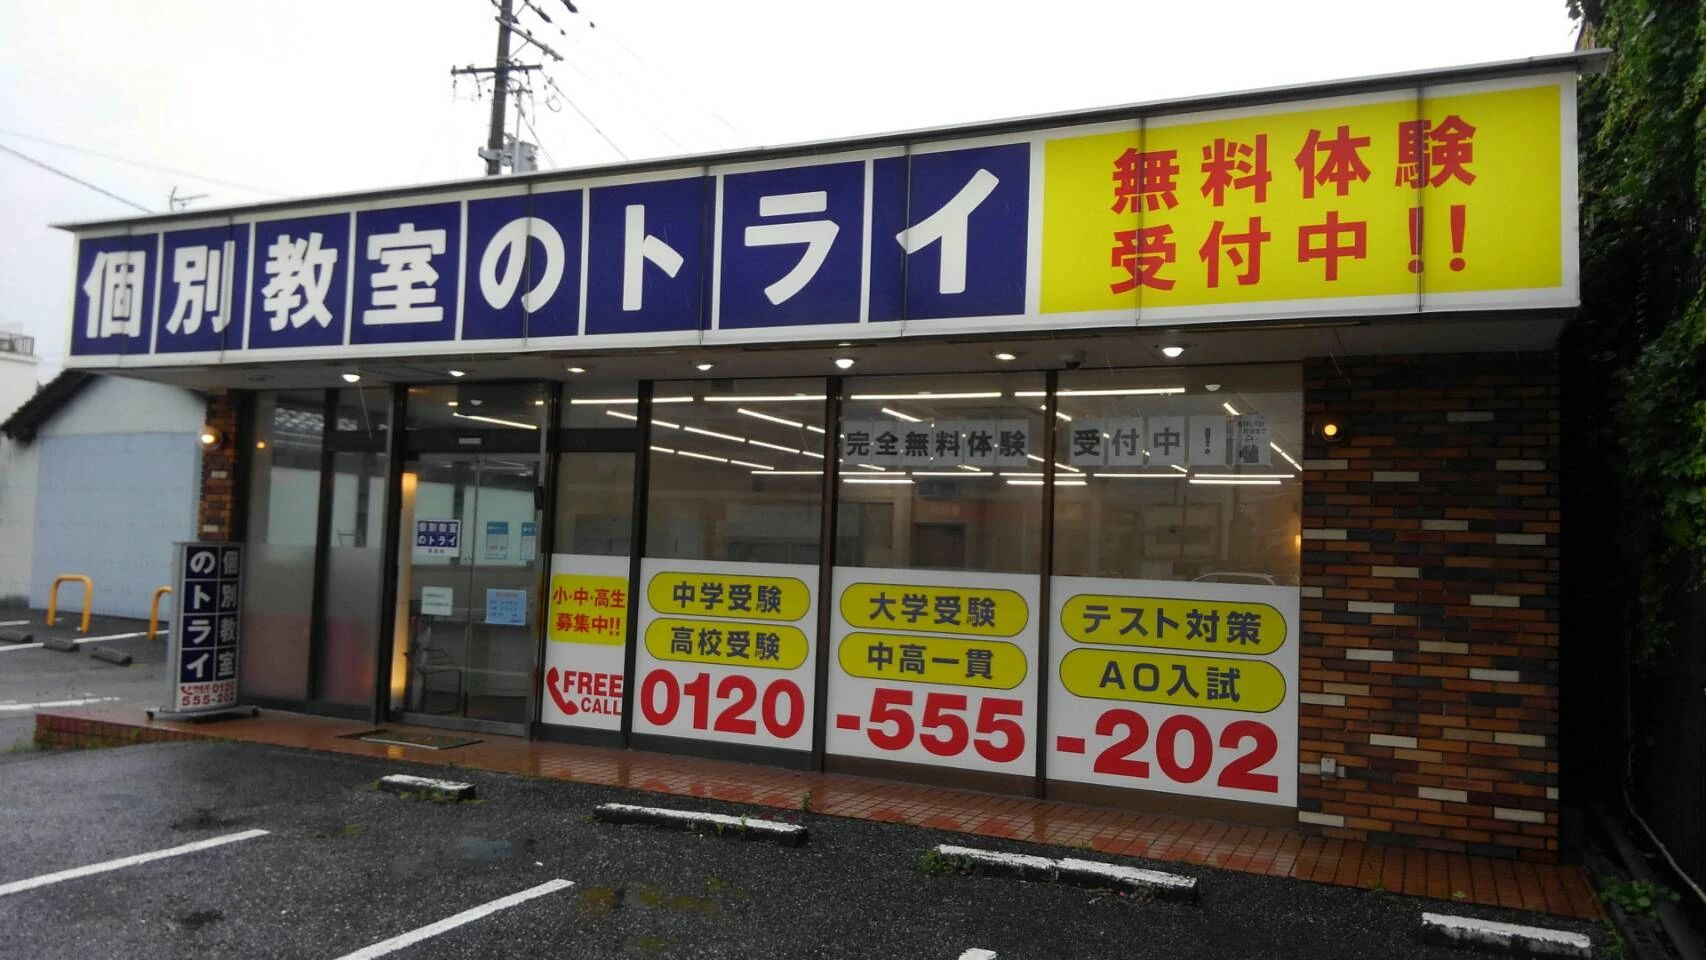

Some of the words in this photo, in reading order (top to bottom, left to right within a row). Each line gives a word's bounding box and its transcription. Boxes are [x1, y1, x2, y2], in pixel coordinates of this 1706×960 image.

[1111, 115, 1477, 215] 無料体験
[84, 168, 999, 339] 個別教室のトライ
[1110, 204, 1466, 294] 受付中!!
[846, 430, 1026, 457] 完全無料体験
[1073, 427, 1212, 456] 受付中!
[672, 581, 782, 613] 中学受験
[869, 592, 996, 627] 大学受験
[556, 612, 621, 636] 募集中!!
[1083, 604, 1262, 645] テスト対策
[671, 626, 780, 661] 高校受験
[868, 641, 994, 680] 中高一貫
[563, 670, 624, 698] FREE
[1099, 660, 1241, 702] AO入試
[580, 696, 622, 716] CALL
[640, 668, 805, 739] 0120
